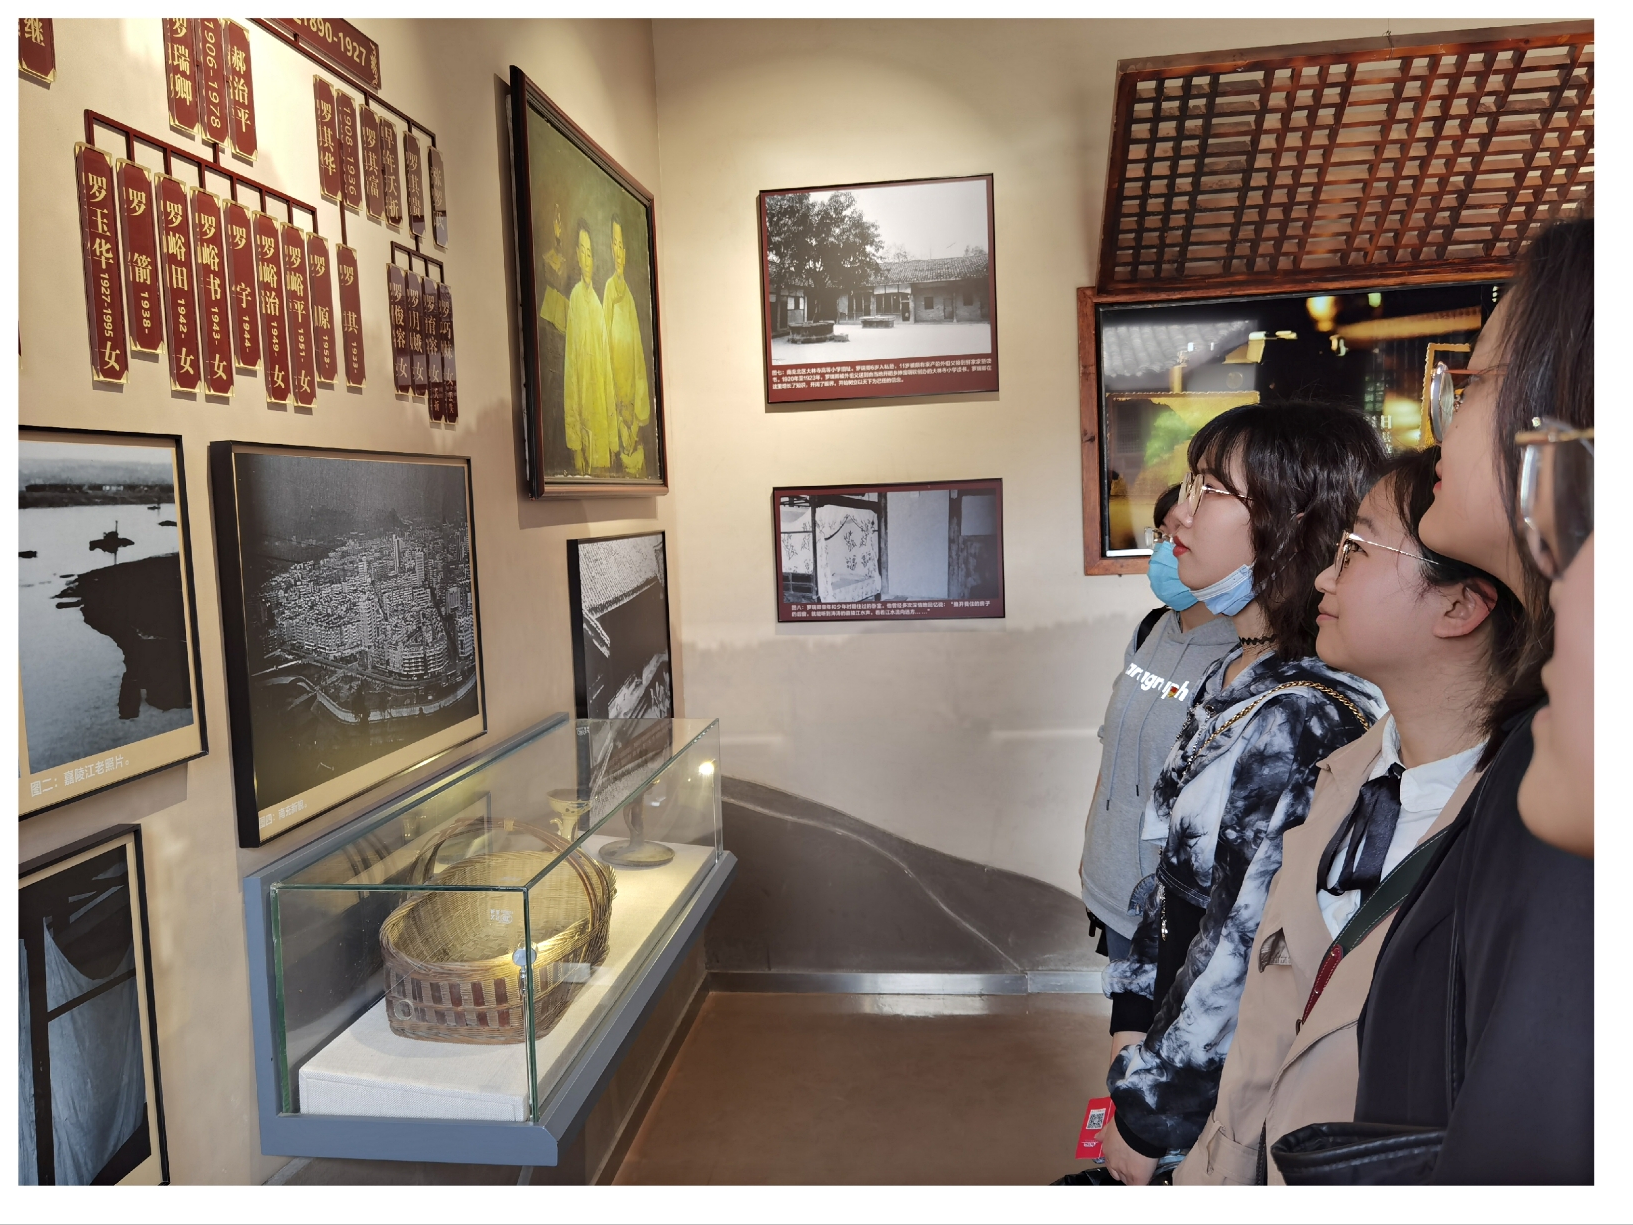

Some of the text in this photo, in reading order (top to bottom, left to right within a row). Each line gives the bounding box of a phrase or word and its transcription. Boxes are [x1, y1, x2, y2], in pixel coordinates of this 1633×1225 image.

[203, 21, 222, 128] 1906-1978
[230, 46, 252, 133] 郝治平
[88, 172, 121, 371] 罗玉华 1927-1995 女
[167, 200, 188, 291] 罗峪田
[178, 347, 195, 375] 女
[201, 212, 222, 301] 罗峪书
[261, 236, 280, 317] 罗峪治
[273, 364, 285, 389] 女
[289, 245, 307, 323] 罗峪平
[299, 370, 311, 393] 女
[211, 353, 227, 380] 女
